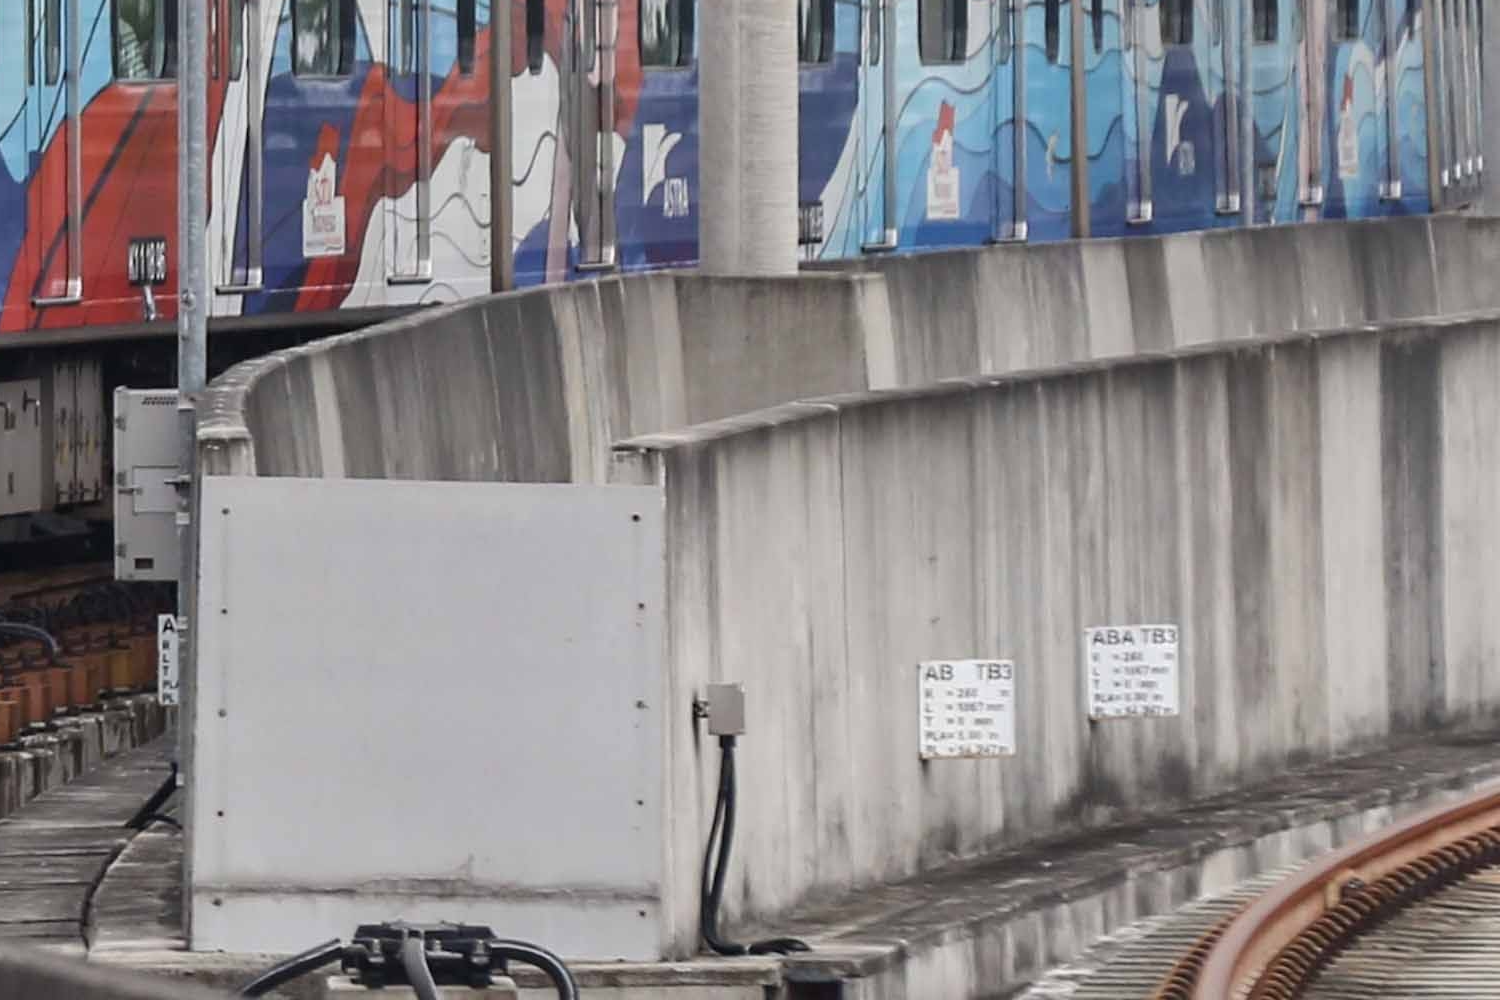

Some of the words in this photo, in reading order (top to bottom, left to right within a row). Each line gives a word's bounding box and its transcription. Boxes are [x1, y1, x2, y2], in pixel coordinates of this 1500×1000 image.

[1092, 629, 1135, 646] ABA
[1140, 627, 1178, 645] TB3
[925, 664, 954, 680] AB
[975, 663, 1013, 680] TB3
